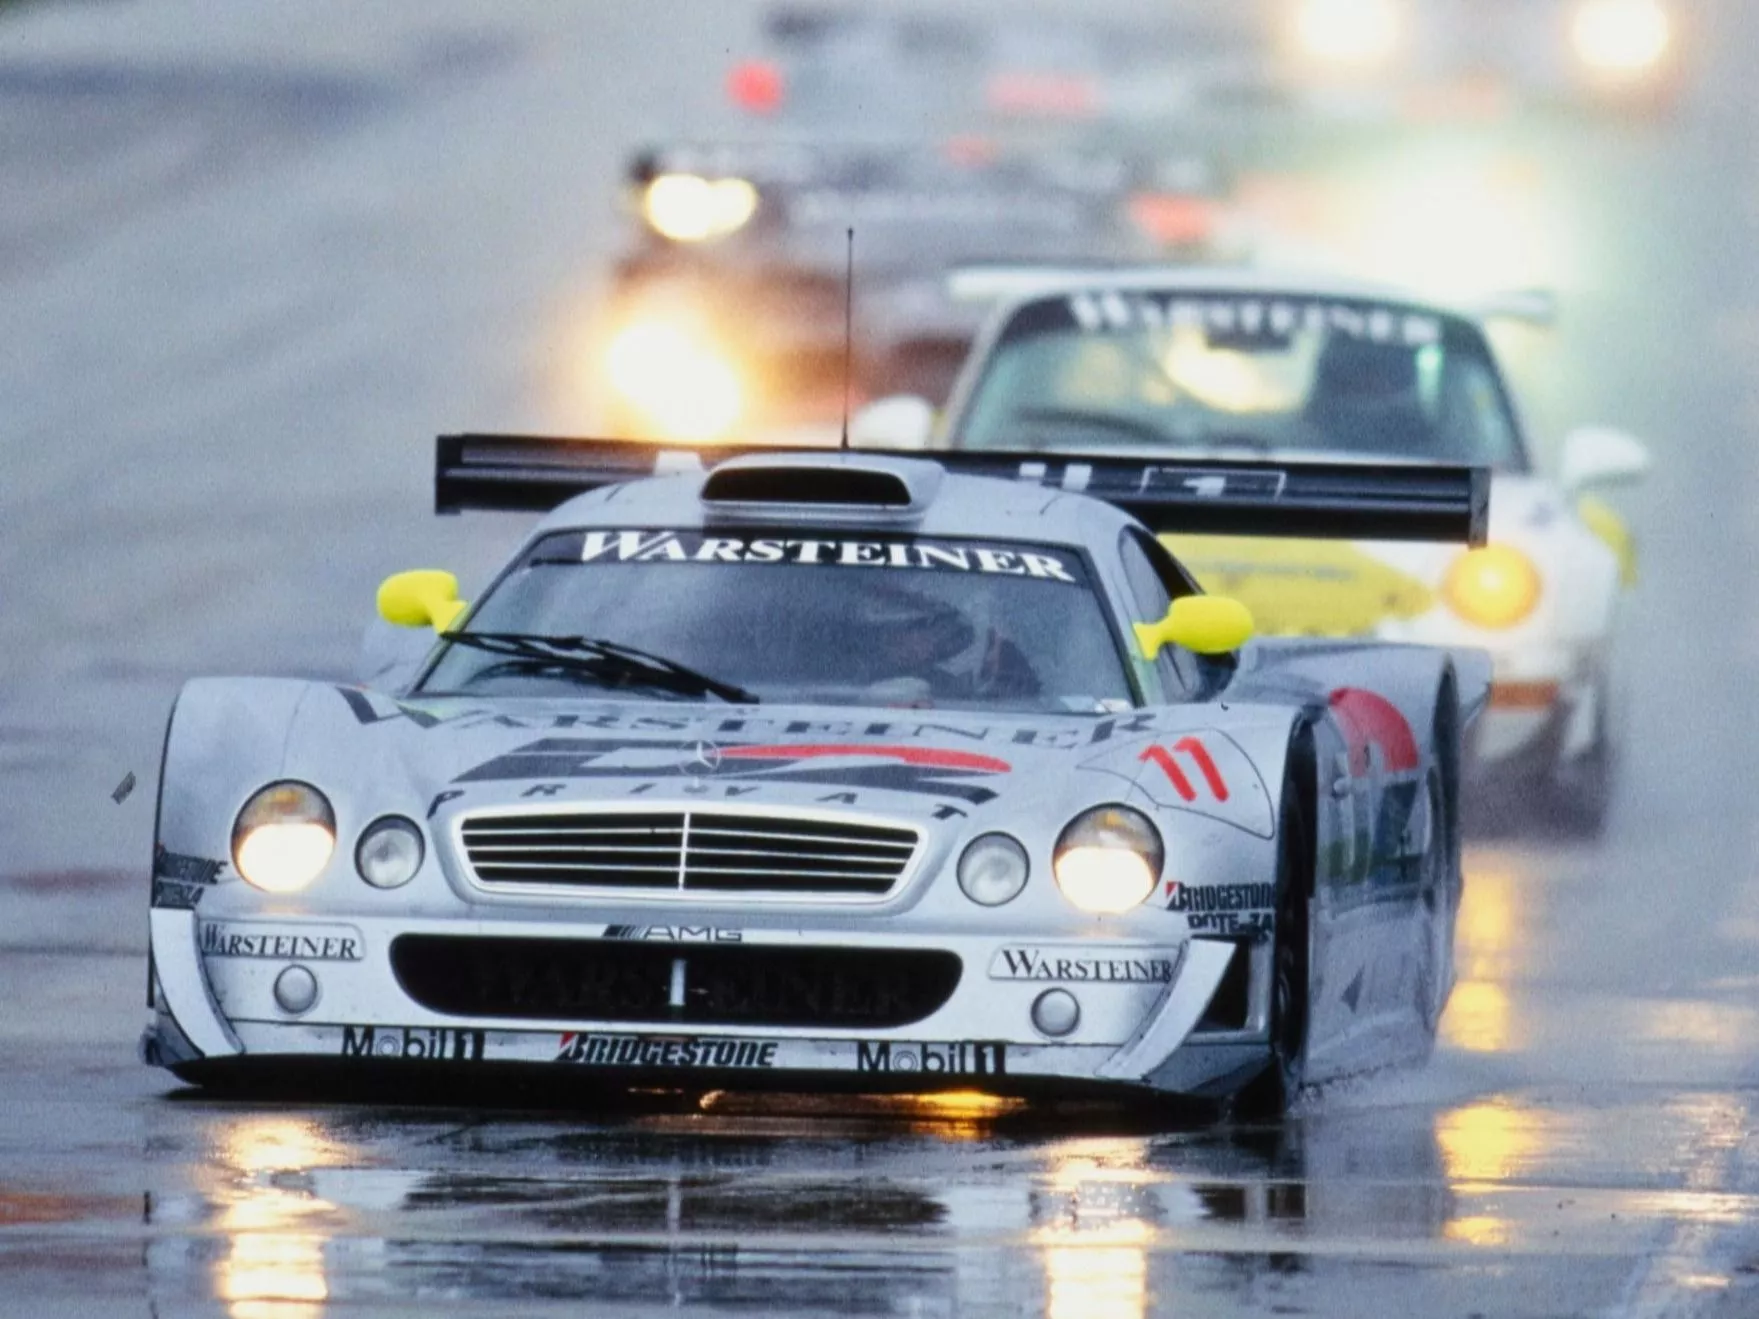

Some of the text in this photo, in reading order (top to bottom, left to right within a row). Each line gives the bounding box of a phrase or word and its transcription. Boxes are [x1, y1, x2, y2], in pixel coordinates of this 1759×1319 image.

[580, 530, 1077, 584] WARSTEINER
[1138, 736, 1230, 802] 11
[203, 923, 356, 959] WARSTEINER
[643, 924, 743, 943] AMG
[1001, 949, 1173, 983] WARSTEINER
[556, 1031, 778, 1067] BRIDGESTONE
